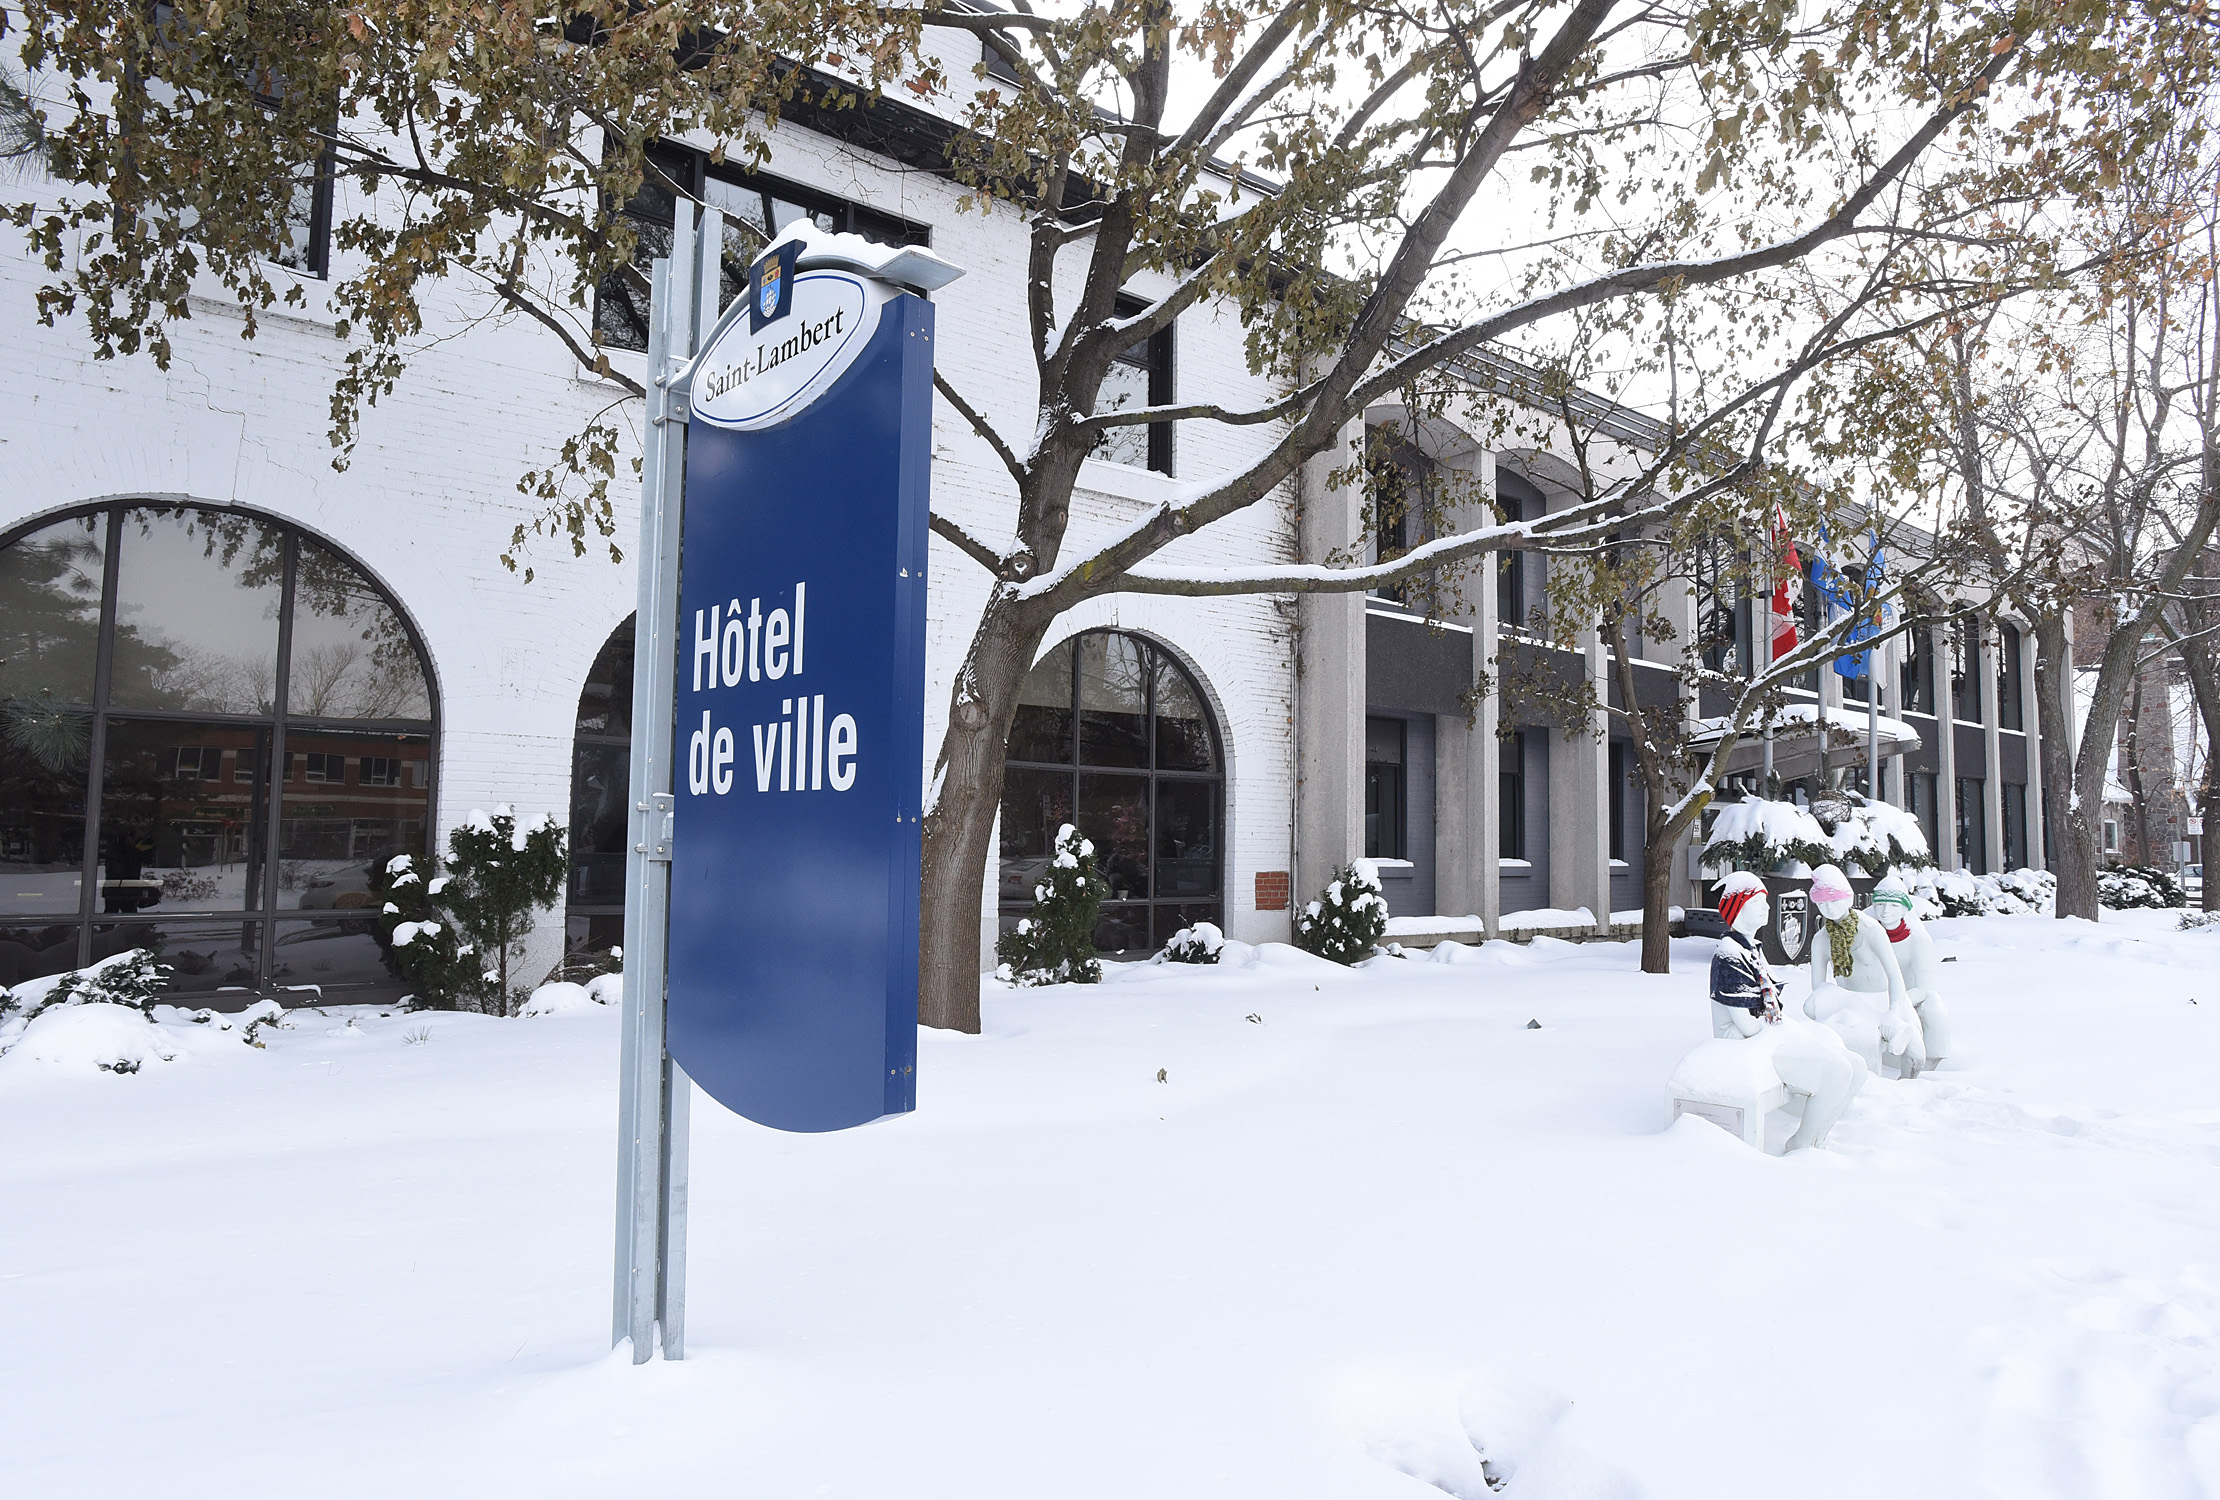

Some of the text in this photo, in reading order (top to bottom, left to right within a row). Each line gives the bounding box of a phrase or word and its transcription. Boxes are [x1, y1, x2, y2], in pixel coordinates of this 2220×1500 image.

[705, 306, 844, 402] Saint-Lambert
[692, 581, 806, 692] Hôtel
[688, 694, 858, 796] de ville
